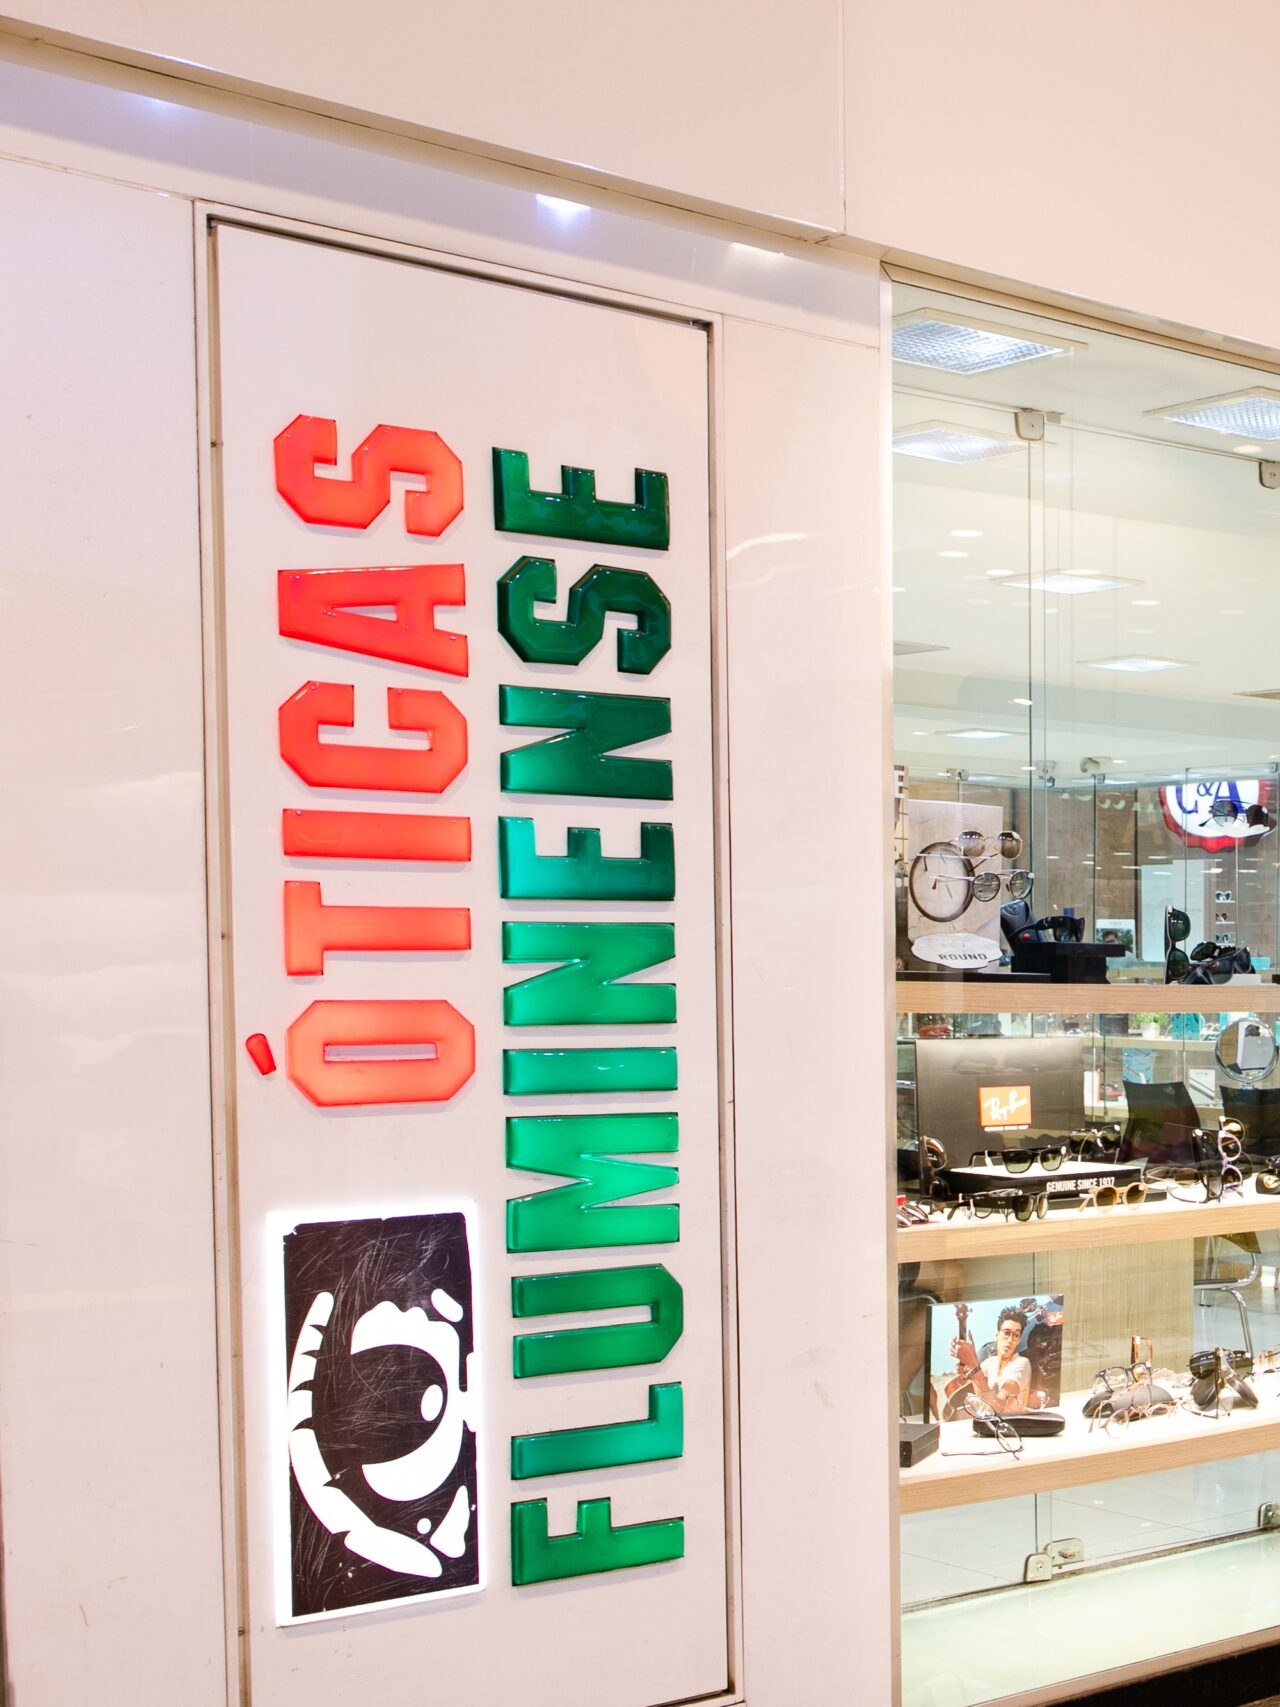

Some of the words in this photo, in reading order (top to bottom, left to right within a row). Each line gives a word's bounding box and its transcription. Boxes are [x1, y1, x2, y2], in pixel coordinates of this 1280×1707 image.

[246, 415, 475, 1107] ÓTICAS
[492, 446, 684, 1588] FLUMINENSE
[1046, 1180, 1076, 1193] GENUINE
[1077, 1178, 1098, 1190] SINCE
